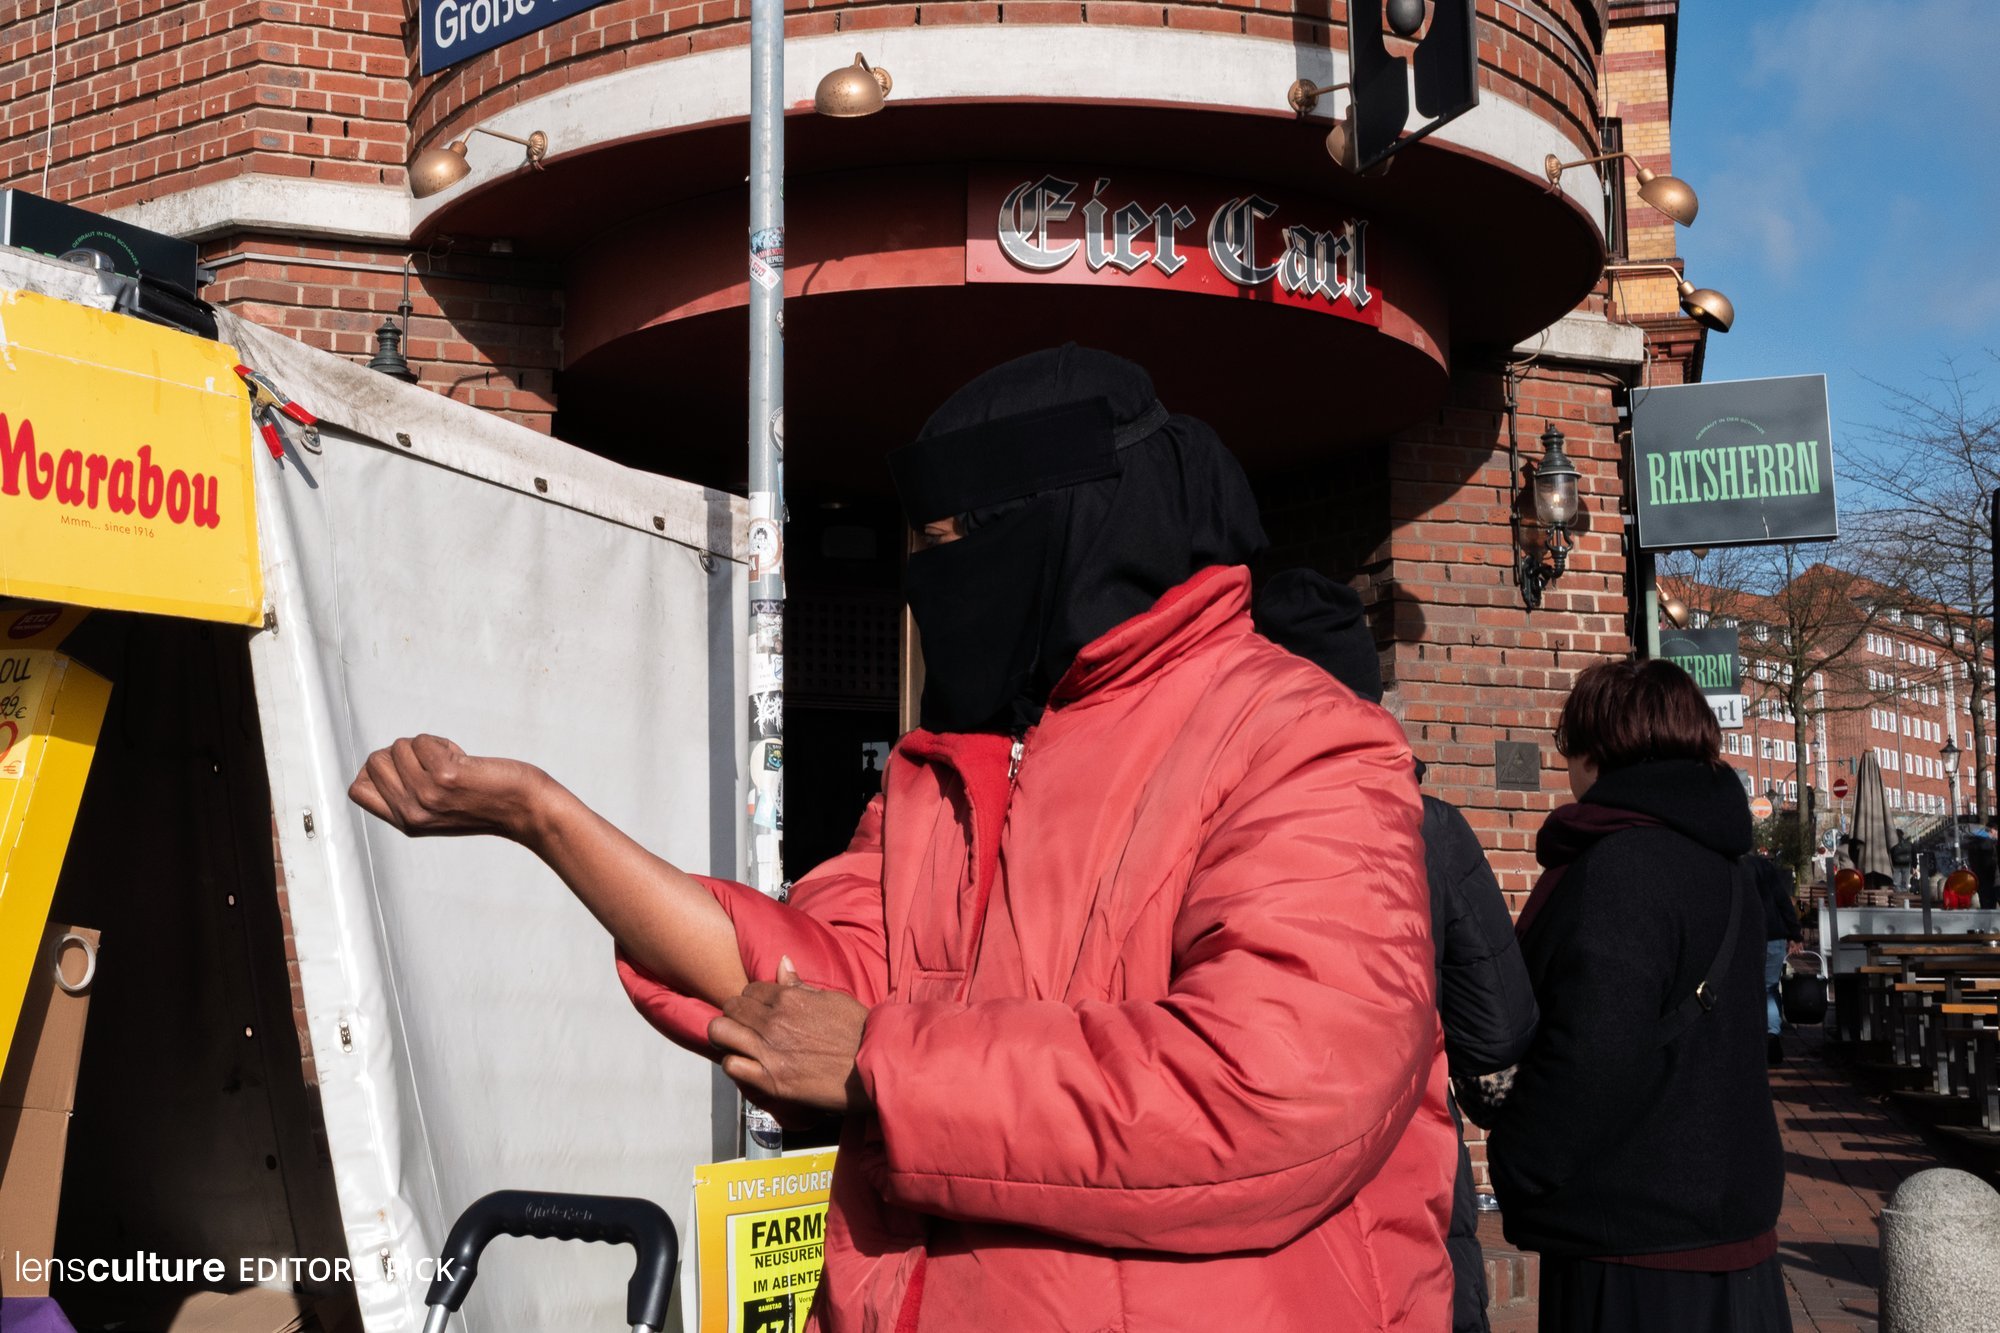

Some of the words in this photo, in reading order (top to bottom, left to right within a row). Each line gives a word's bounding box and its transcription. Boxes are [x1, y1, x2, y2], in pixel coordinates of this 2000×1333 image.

[72, 231, 95, 249] GEBRAUT
[104, 232, 117, 241] DER
[998, 174, 1196, 277] Eier
[1208, 194, 1373, 307] Carl
[0, 412, 220, 530] Marabou
[1647, 440, 1820, 506] RATSHERRN
[61, 515, 101, 531] Mmm...
[104, 522, 131, 535] since
[134, 526, 155, 538] 1916
[753, 1279, 768, 1293] IM
[758, 1302, 782, 1313] SAMSTAG
